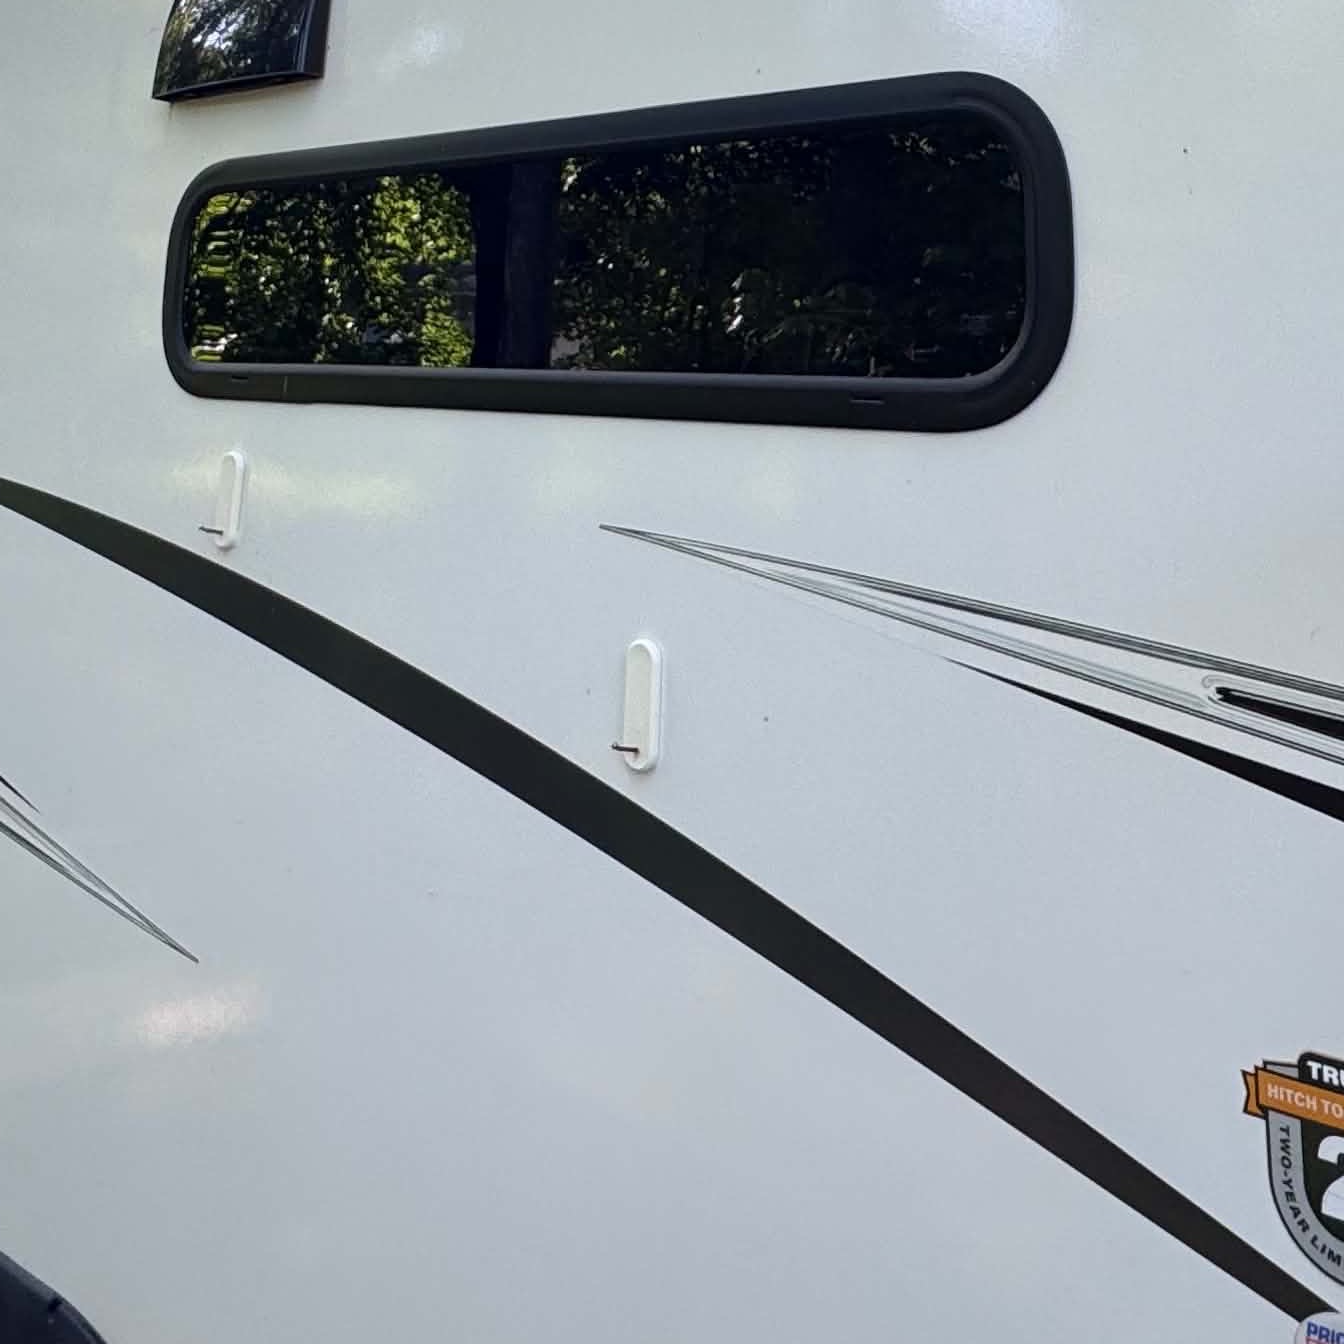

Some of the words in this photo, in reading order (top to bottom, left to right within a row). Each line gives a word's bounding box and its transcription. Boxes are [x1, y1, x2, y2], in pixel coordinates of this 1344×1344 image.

[1267, 1084, 1318, 1111] HITCH
[1320, 1100, 1344, 1118] TO
[1279, 1124, 1311, 1235] TWO-YEAR
